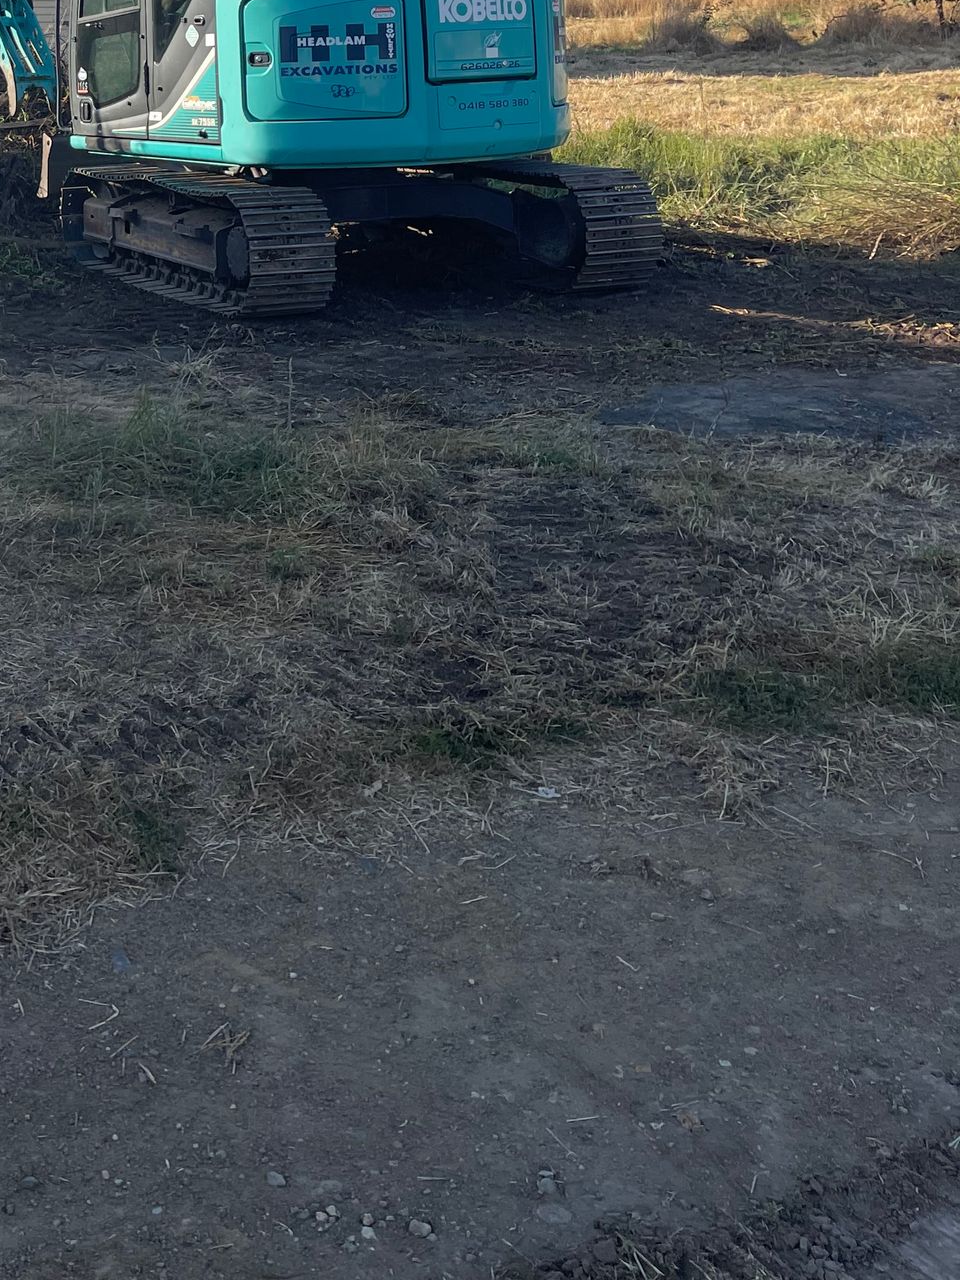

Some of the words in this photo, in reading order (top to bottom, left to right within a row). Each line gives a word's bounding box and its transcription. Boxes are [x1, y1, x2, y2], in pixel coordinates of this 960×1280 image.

[297, 35, 366, 47] HEADLAM
[280, 64, 398, 78] EXCAVATIONS
[458, 102, 486, 110] 0418
